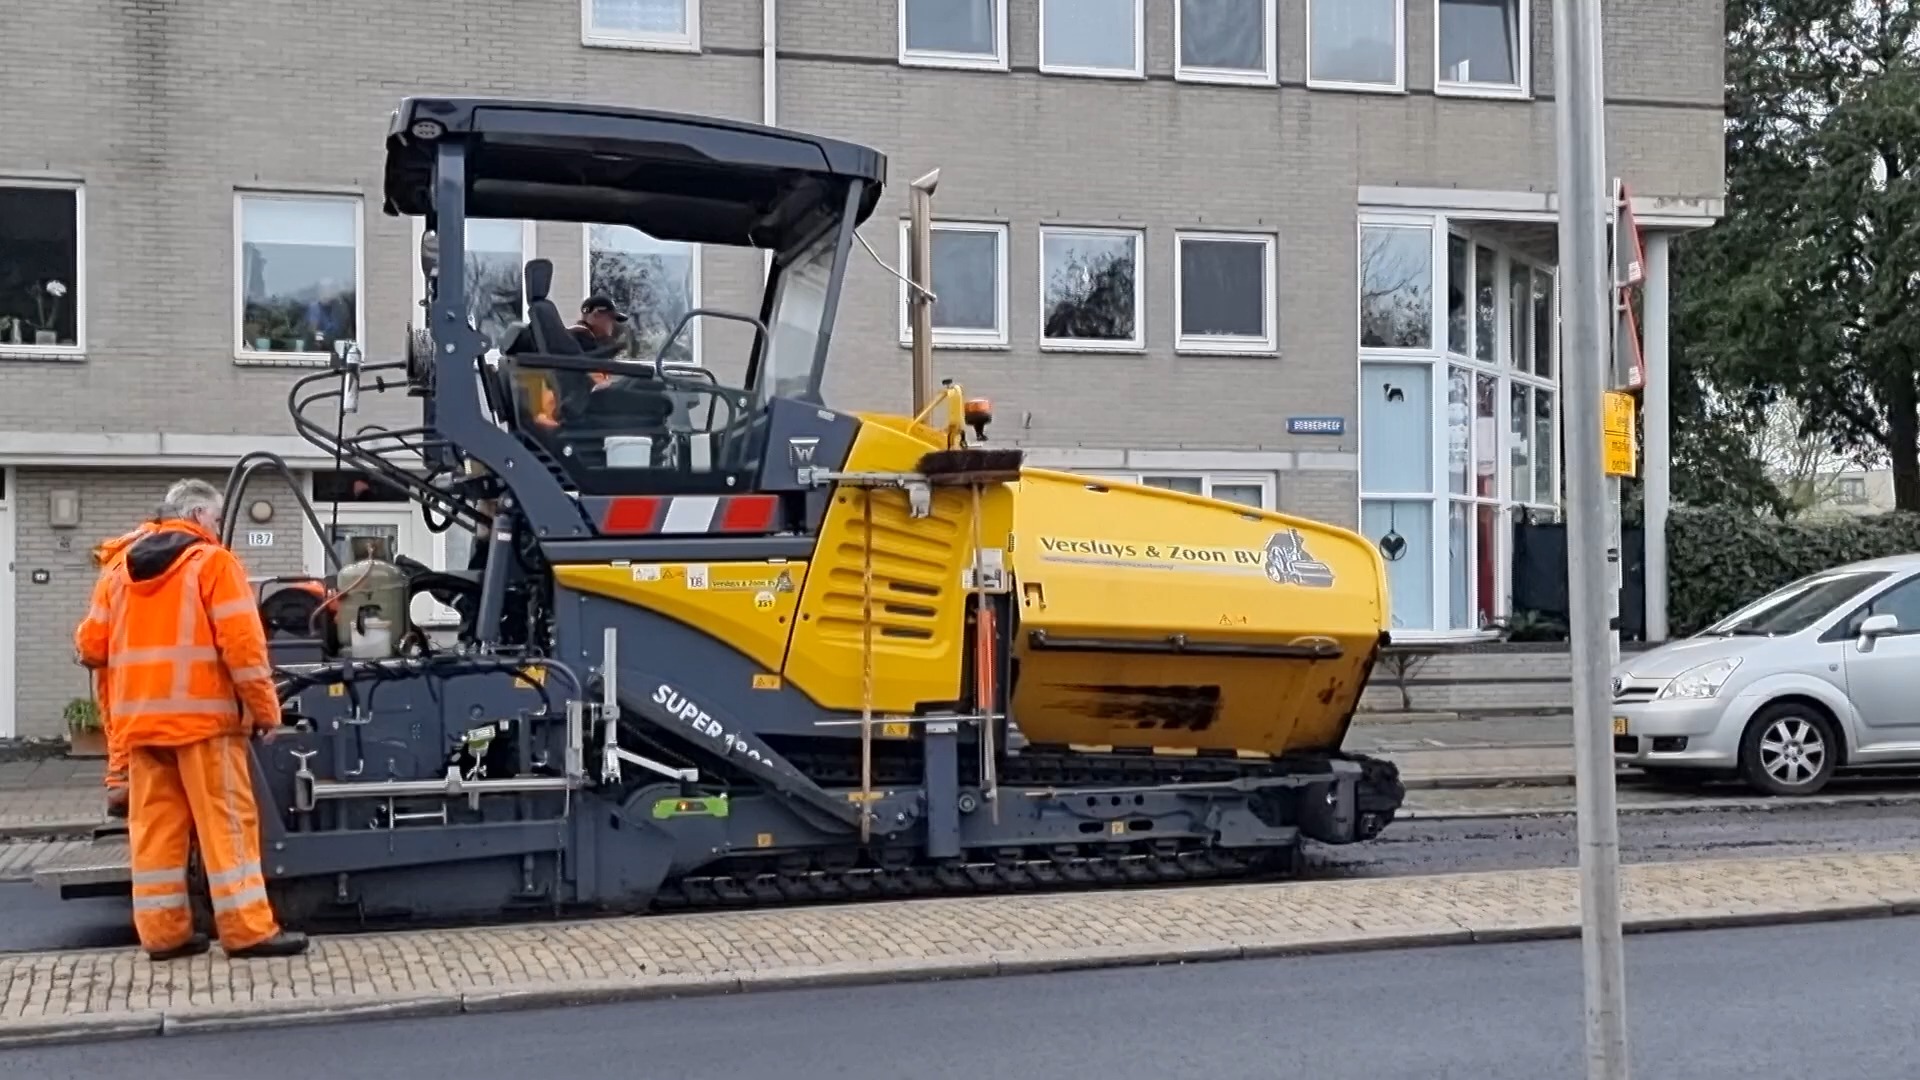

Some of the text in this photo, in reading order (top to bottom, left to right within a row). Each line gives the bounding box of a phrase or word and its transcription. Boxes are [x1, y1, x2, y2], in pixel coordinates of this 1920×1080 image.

[250, 533, 271, 544] 187
[1040, 537, 1261, 565] Versluys & Zoon BV
[652, 684, 724, 738] SUPER
